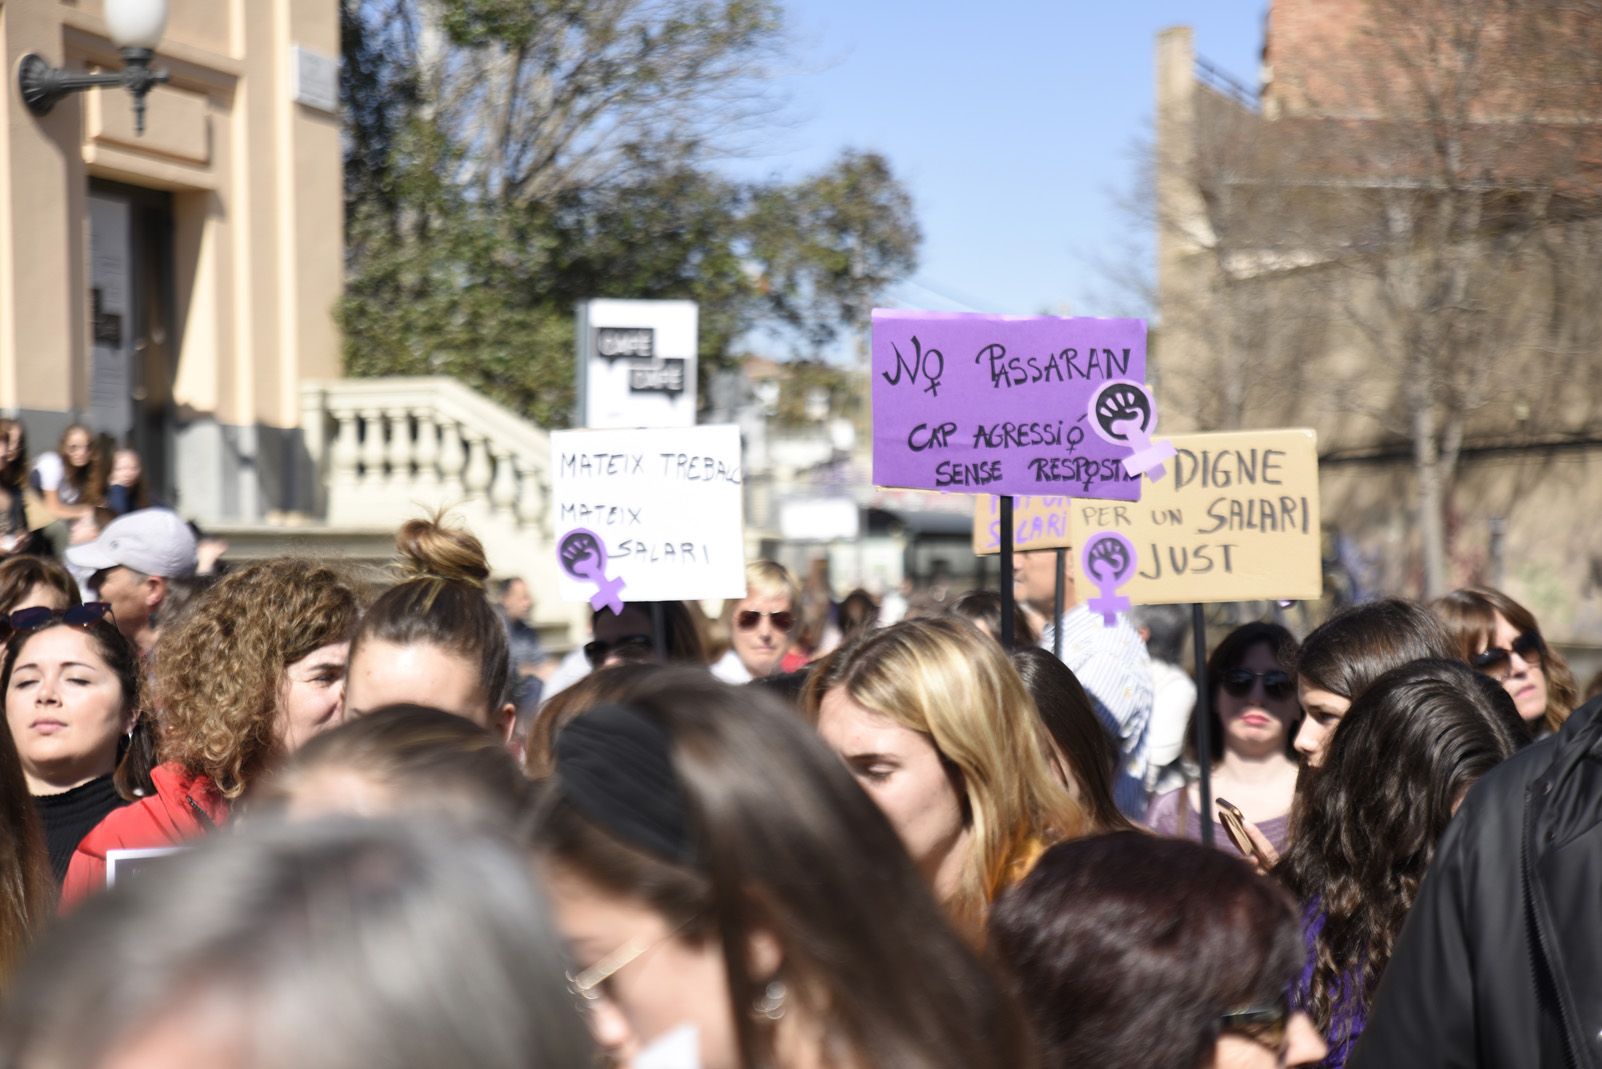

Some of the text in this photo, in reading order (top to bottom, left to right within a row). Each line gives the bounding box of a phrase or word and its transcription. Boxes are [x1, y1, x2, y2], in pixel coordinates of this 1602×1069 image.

[882, 335, 1131, 397] NO PASSARAN
[907, 421, 957, 452] CAP
[561, 452, 644, 478] MATEIX
[935, 460, 1003, 487] SENSE
[1173, 448, 1286, 492] DIGNE
[561, 502, 641, 525] MATEIX
[1082, 505, 1132, 527] PER
[1151, 508, 1183, 526] UN
[1197, 496, 1309, 535] SALARI
[607, 539, 709, 564] SALARI
[1139, 543, 1238, 580] JUST
